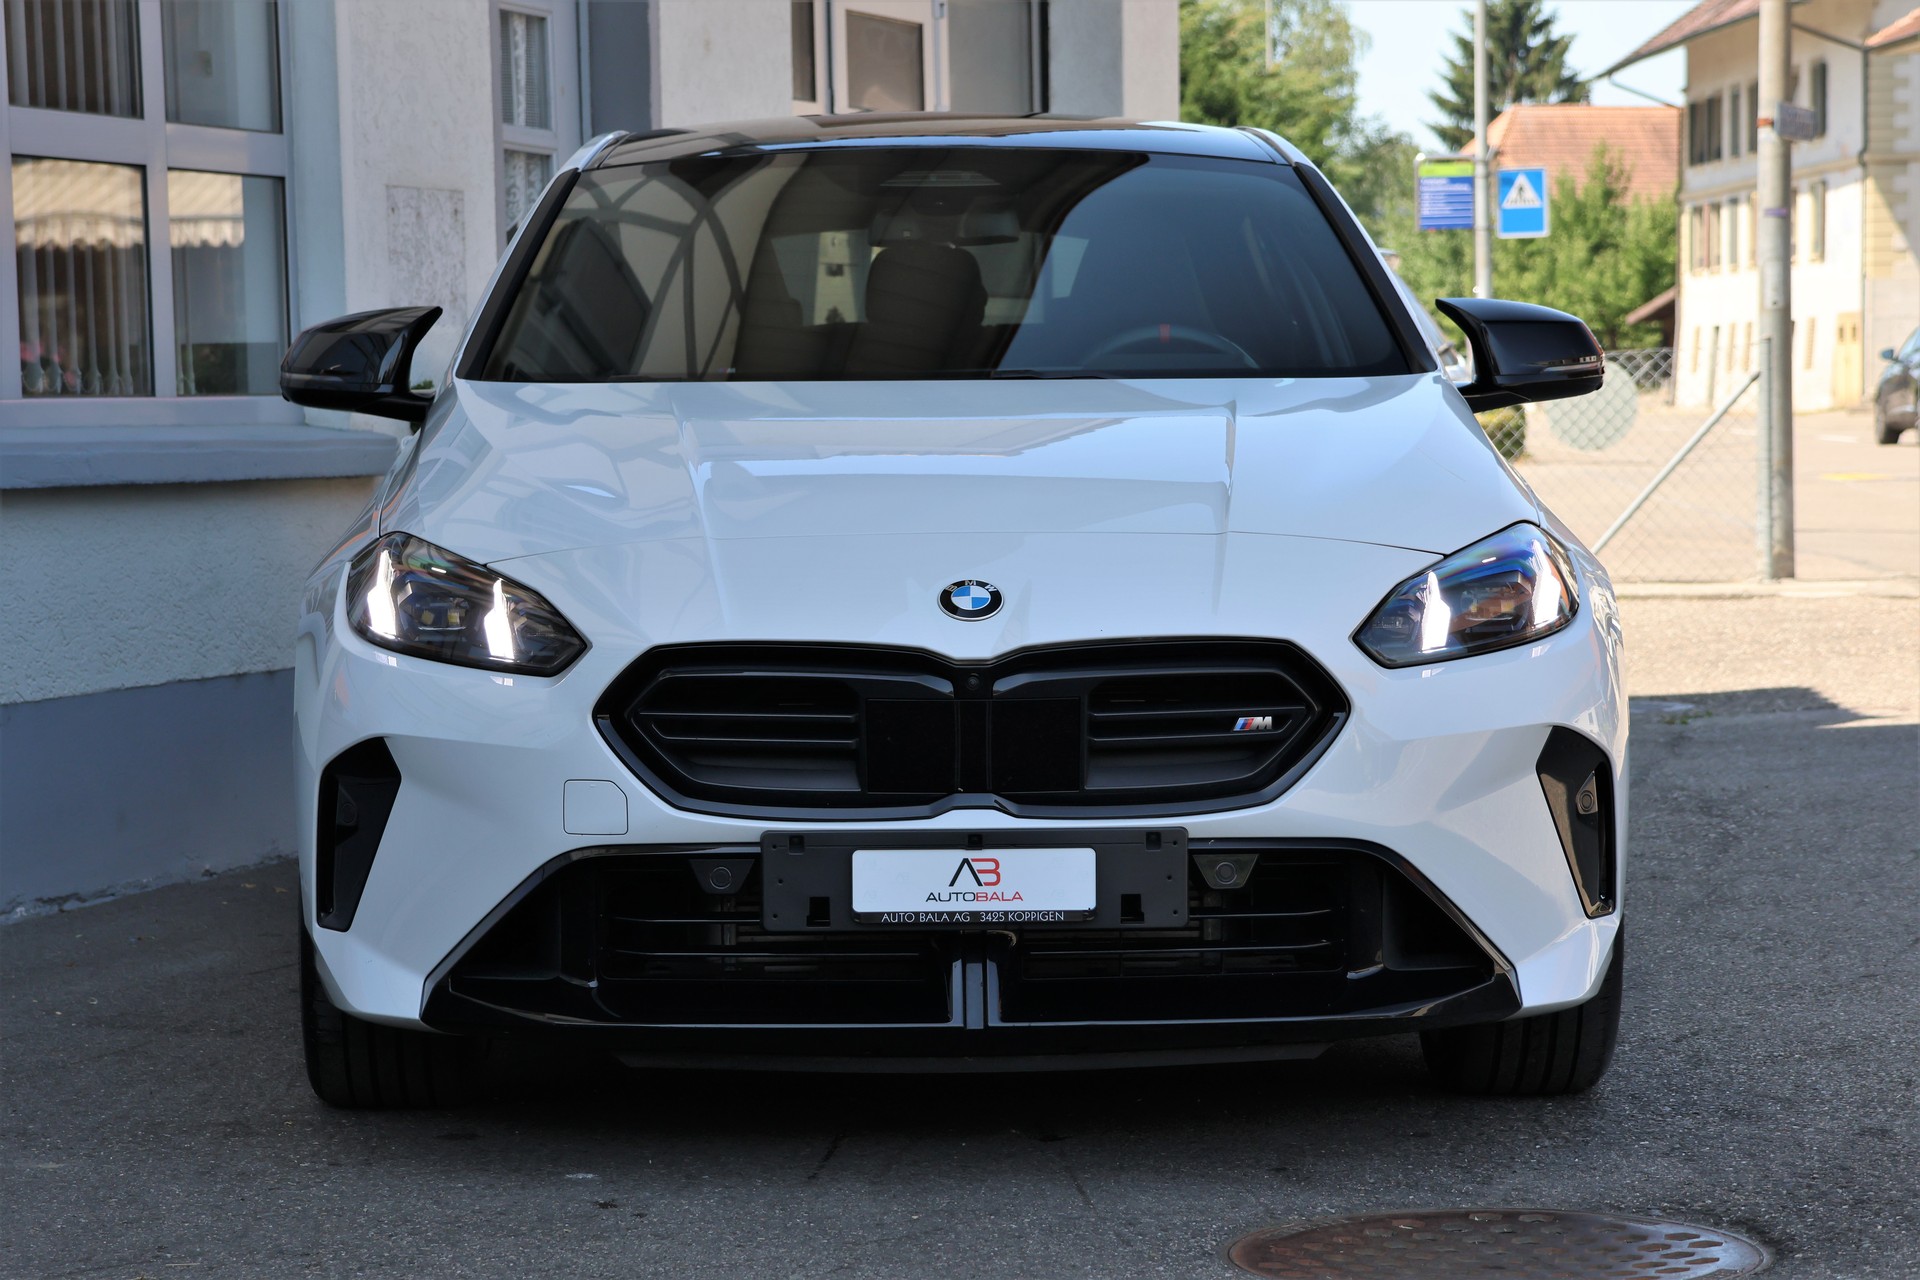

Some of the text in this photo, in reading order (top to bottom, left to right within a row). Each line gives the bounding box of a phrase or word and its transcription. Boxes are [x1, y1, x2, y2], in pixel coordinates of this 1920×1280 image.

[945, 580, 997, 592] BMW
[948, 858, 1001, 887] AB
[925, 891, 1024, 903] AUTOBALA
[881, 911, 1065, 923] AUTO BALA AG 3425 KOPPIGEN
